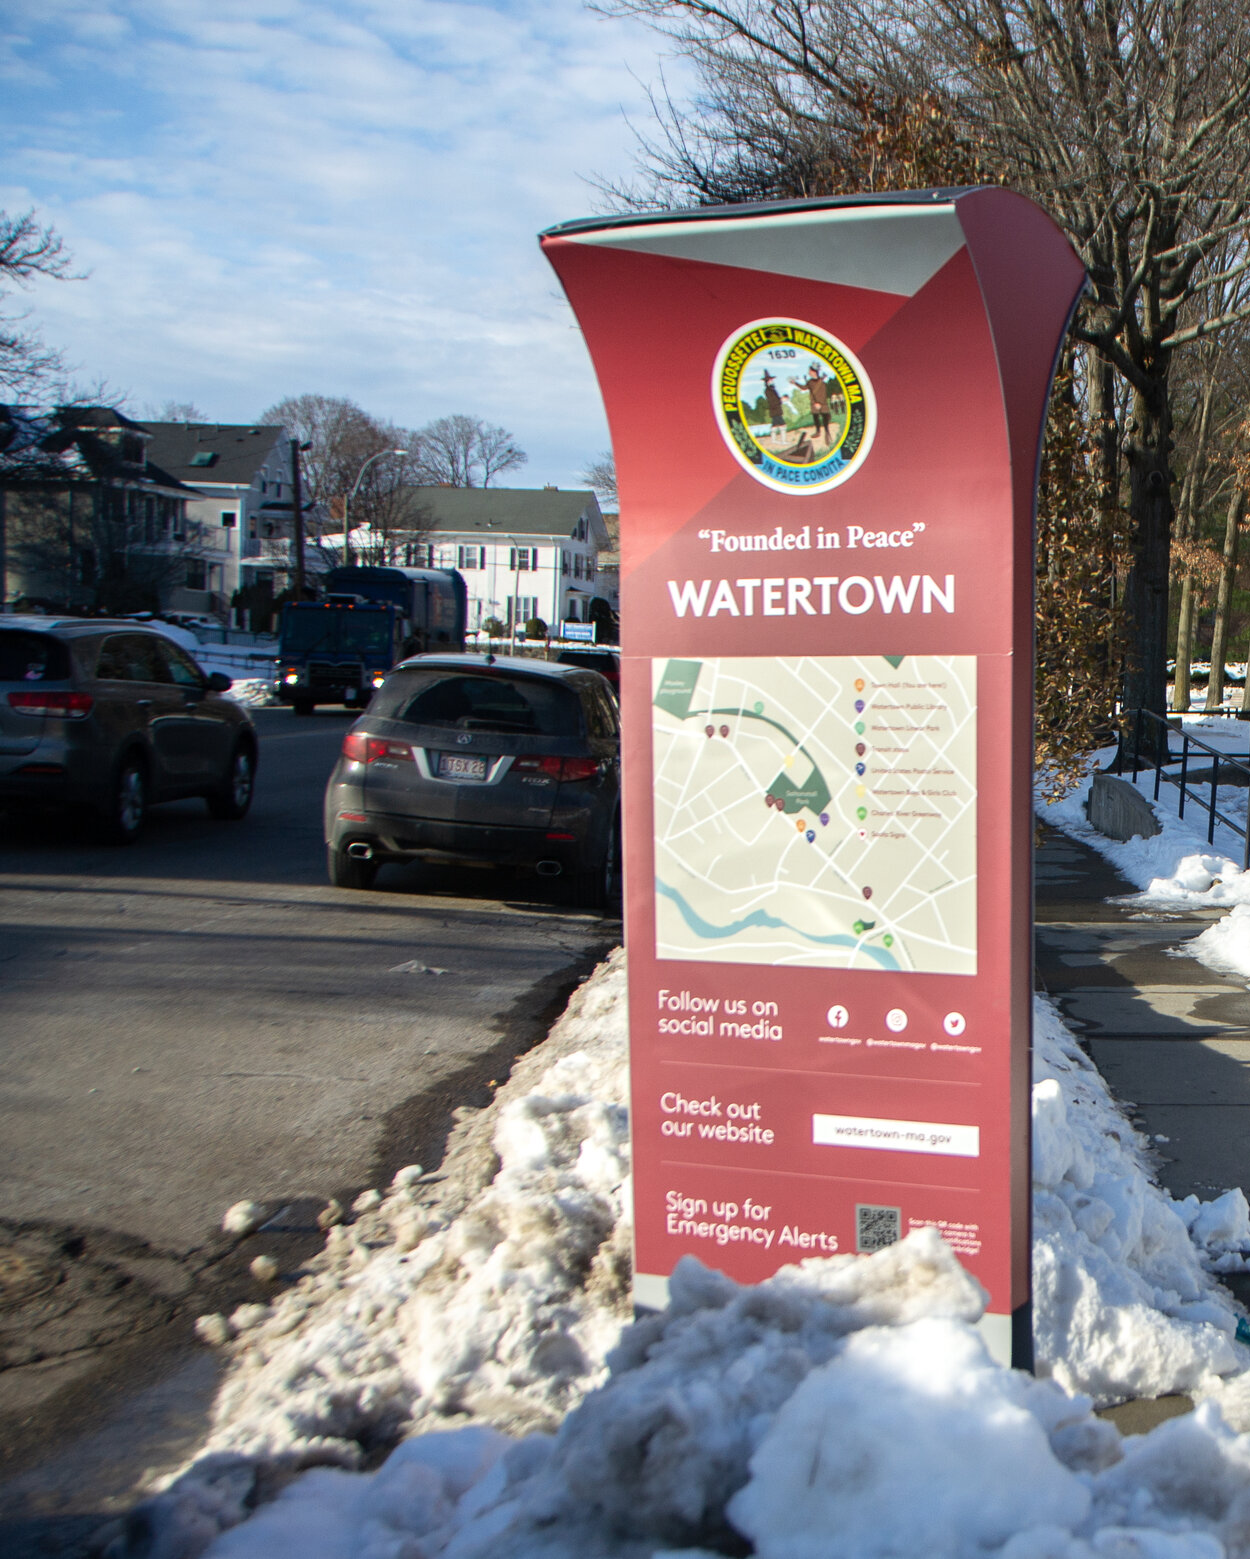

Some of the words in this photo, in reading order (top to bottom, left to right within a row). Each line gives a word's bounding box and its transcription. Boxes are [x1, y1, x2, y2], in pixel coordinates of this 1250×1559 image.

[768, 349, 796, 360] 1630
[794, 329, 856, 385] WATERTOWN
[847, 384, 863, 405] MA
[725, 332, 764, 412] PEQUOSSETTE
[763, 460, 774, 474] IN
[776, 465, 801, 482] PACE
[803, 456, 845, 483] CONDITA
[698, 526, 811, 552] “Founded
[816, 527, 840, 549] in
[846, 522, 926, 549] Peace”
[667, 574, 955, 617] WATERTOWN
[658, 989, 720, 1013] Follow
[724, 1000, 748, 1015] us
[752, 1001, 778, 1017] on
[658, 1015, 714, 1036] social
[719, 1018, 783, 1041] media
[660, 1092, 722, 1117] Check
[727, 1102, 761, 1120] out
[661, 1120, 695, 1137] our
[698, 1120, 775, 1145] website
[834, 1126, 952, 1146] watertown-ma.gov
[666, 1190, 707, 1219] Sign
[712, 1201, 739, 1222] up
[743, 1198, 772, 1221] for
[666, 1213, 776, 1249] Emergency
[778, 1225, 838, 1251] Alerts
